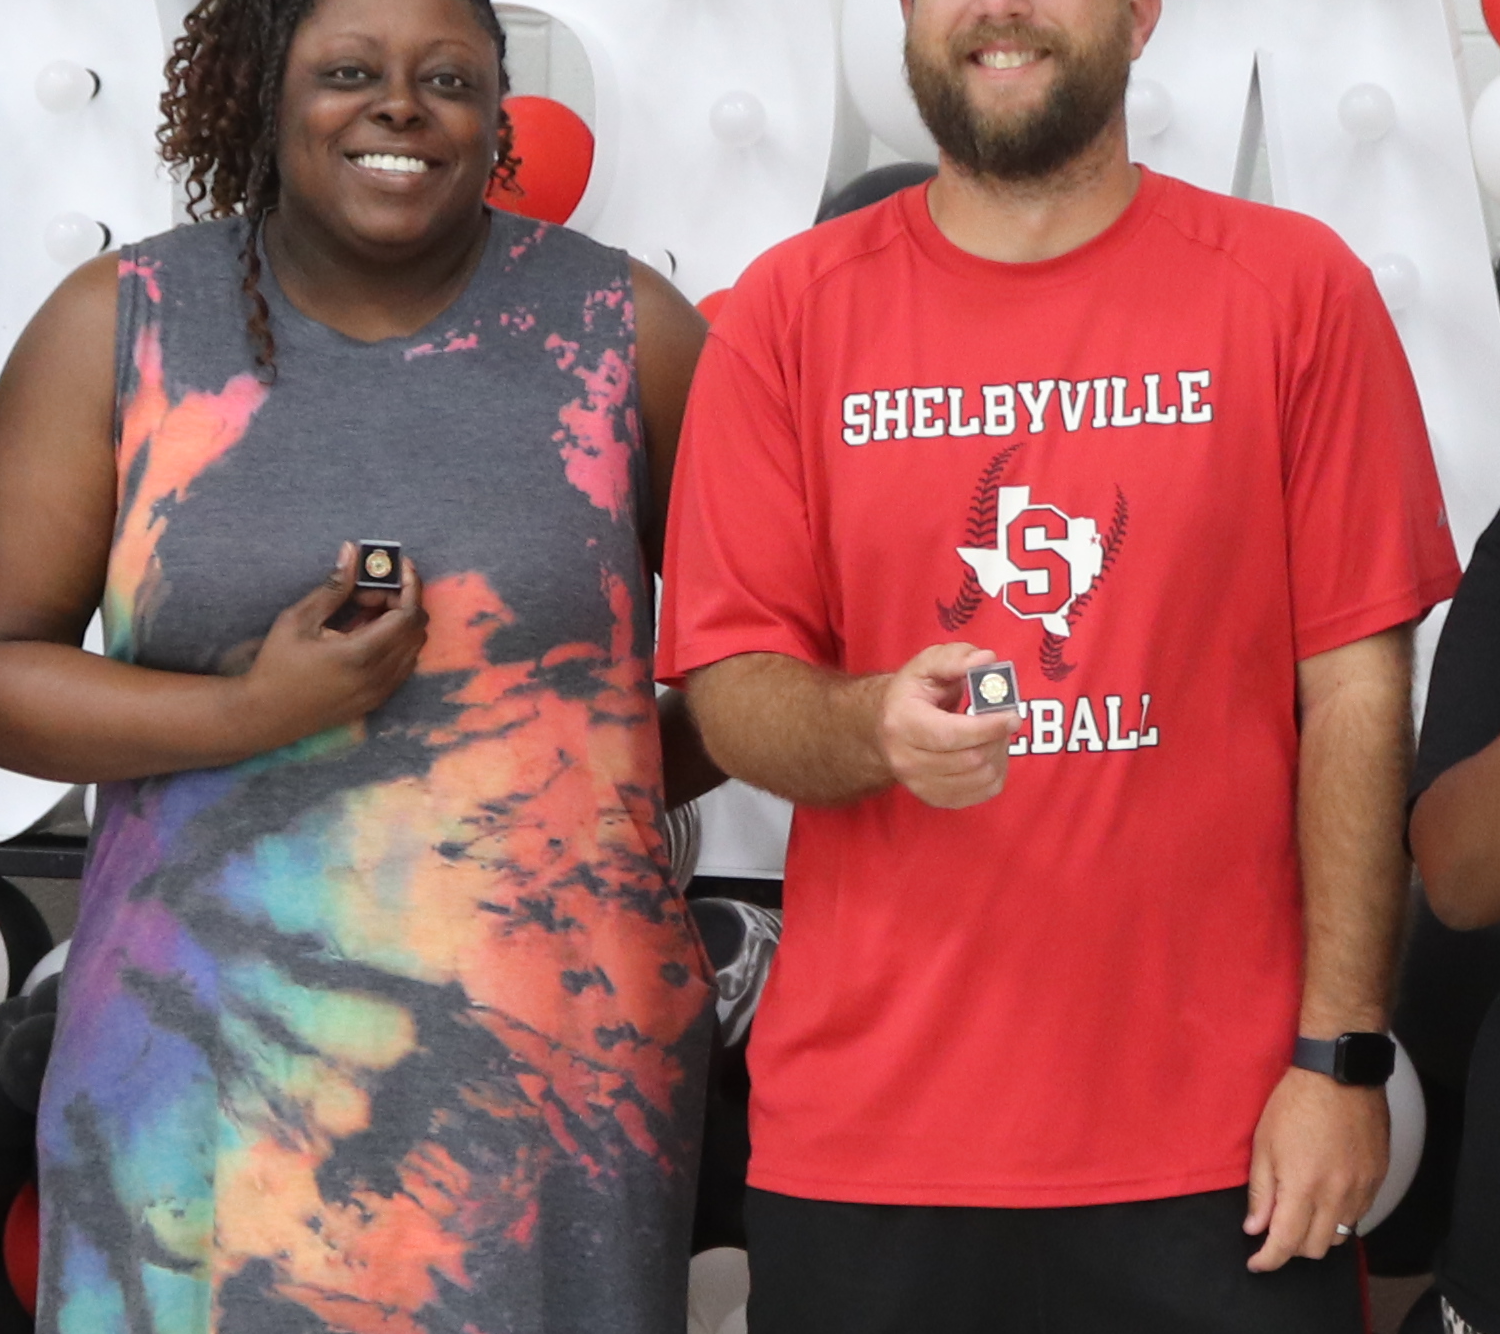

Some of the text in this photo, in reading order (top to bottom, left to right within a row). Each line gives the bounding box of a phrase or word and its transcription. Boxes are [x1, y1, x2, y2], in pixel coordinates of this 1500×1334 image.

[841, 370, 1213, 446] SHELBYVILLE
[1003, 504, 1074, 619] S
[966, 694, 1159, 756] BALL
